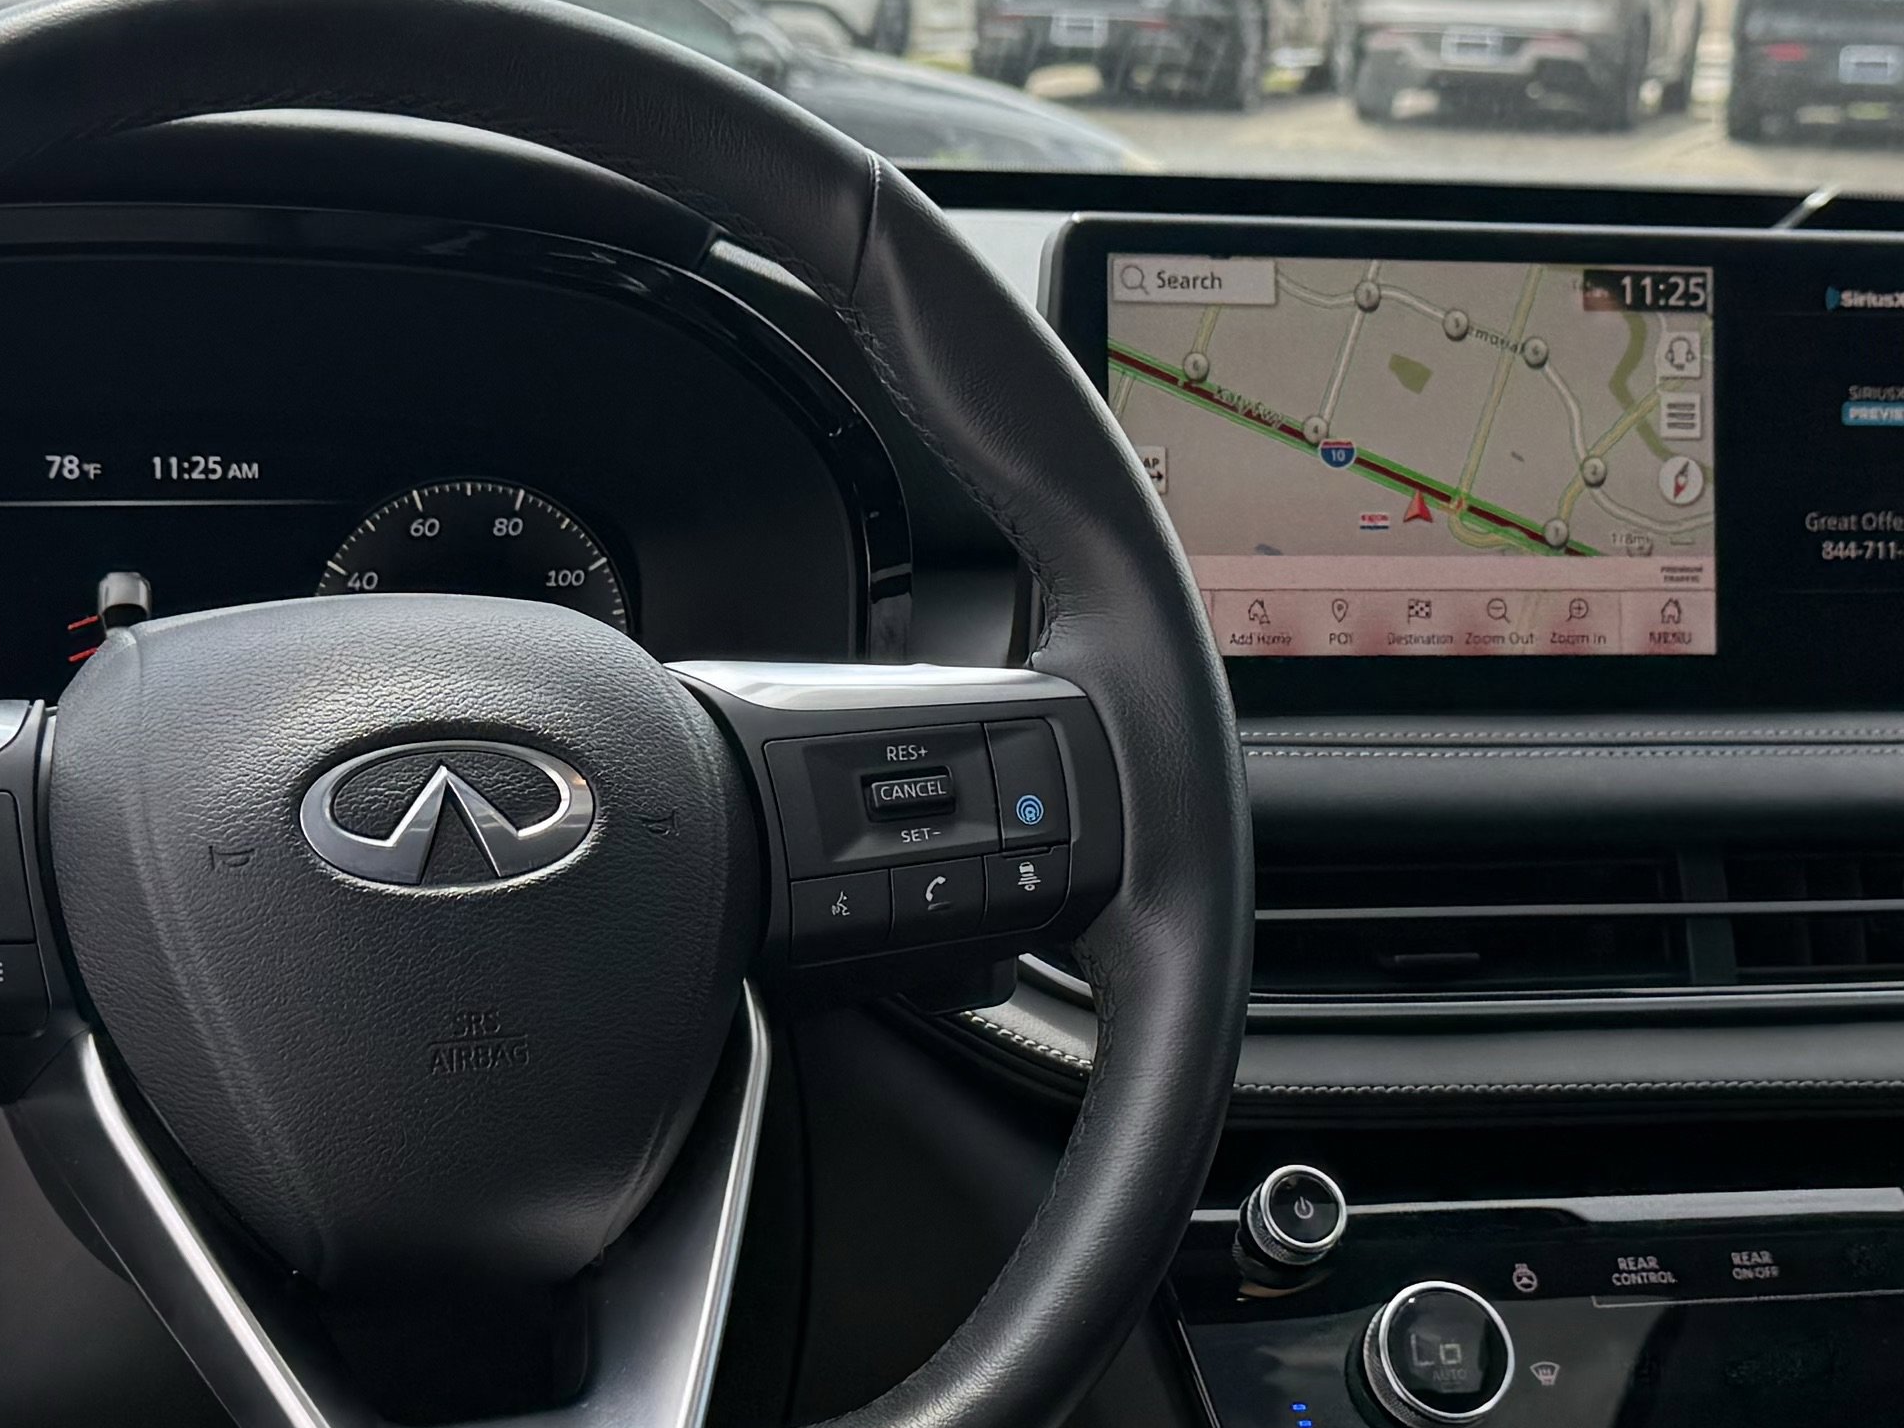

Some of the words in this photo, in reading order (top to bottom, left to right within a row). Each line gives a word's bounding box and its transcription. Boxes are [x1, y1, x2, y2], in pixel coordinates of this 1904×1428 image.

[1156, 270, 1222, 290] Search
[1621, 275, 1706, 307] 11:25
[1331, 448, 1346, 462] 10
[152, 455, 223, 481] 11:25
[227, 462, 260, 480] AM
[409, 517, 441, 538] 60
[492, 517, 524, 537] 80
[1805, 511, 1857, 532] Great
[347, 571, 379, 591] 40
[545, 569, 585, 588] 100
[1387, 632, 1454, 646] Destination
[1465, 632, 1505, 646] Zoom
[1508, 632, 1535, 646] Out
[1549, 632, 1590, 646] Zoom
[886, 744, 929, 762] RES+
[880, 780, 947, 801] CANCEL
[1617, 1255, 1660, 1272] REAR
[1730, 1250, 1774, 1266] REAR
[1611, 1271, 1678, 1287] CONTROL
